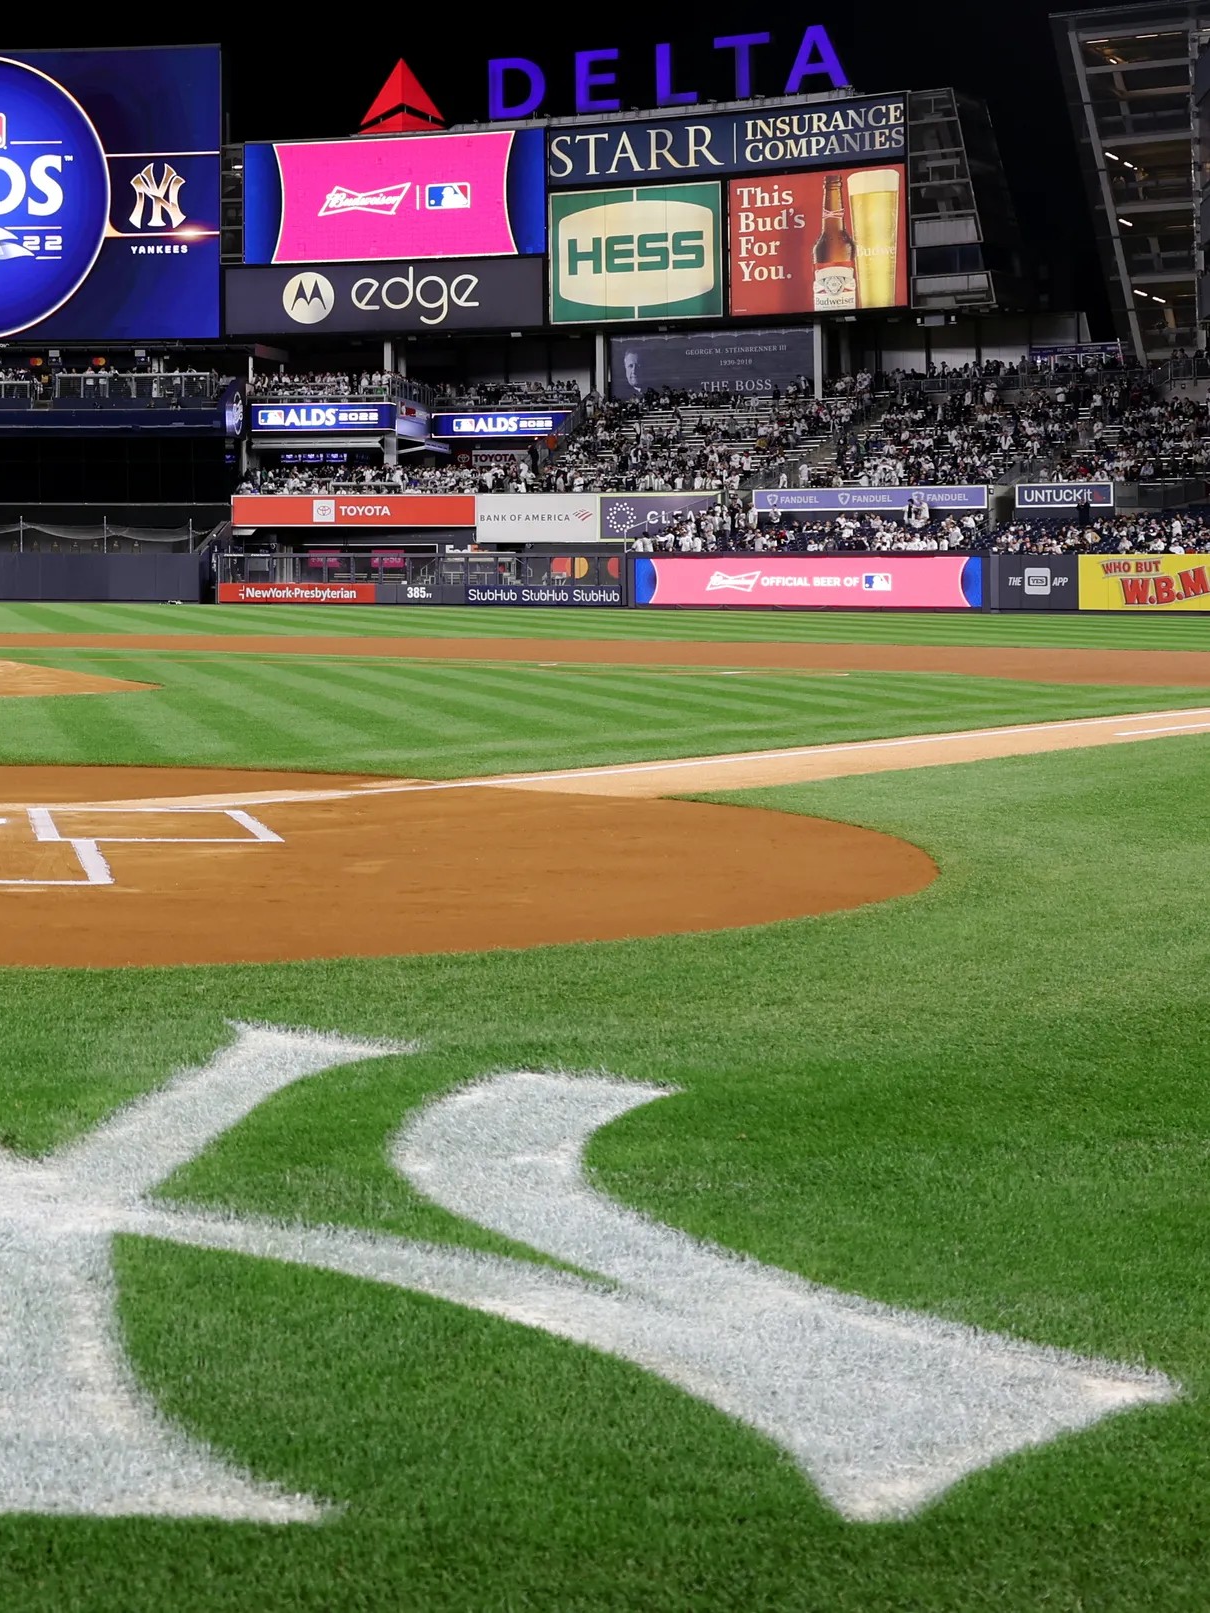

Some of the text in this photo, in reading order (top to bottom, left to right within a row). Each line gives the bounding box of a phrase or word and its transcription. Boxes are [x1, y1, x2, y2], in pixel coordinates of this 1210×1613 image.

[488, 24, 850, 119] DELTA
[745, 103, 905, 140] INSURANCE
[550, 125, 724, 177] STARR
[745, 126, 905, 164] COMPANIES
[737, 185, 793, 208] This
[738, 206, 805, 234] Bud's
[131, 244, 188, 255] YANKEES
[568, 230, 705, 276] HESS
[738, 236, 780, 258] For
[738, 260, 792, 282] You.
[351, 266, 479, 325] edge
[815, 297, 854, 306] Budweiser
[725, 346, 777, 354] STEINBRENNER
[701, 379, 772, 392] THE BOSS
[285, 409, 379, 426] ALDS 2022
[475, 417, 553, 432] ALDS 2022
[473, 454, 516, 462] TOYOTA
[780, 496, 819, 504] FANDUEL
[852, 494, 892, 503] FANDUEL
[927, 493, 968, 502] FANDUEL
[1024, 488, 1092, 502] UNTUCKit
[339, 504, 390, 517] TOYOTA
[480, 513, 570, 522] BANK OF AMERICA
[1102, 560, 1161, 575] WHO BUT
[761, 576, 810, 586] OFFICIAL
[813, 576, 841, 586] BEER
[843, 576, 860, 586] OF
[1008, 577, 1022, 586] THE
[1052, 577, 1068, 586] APP
[468, 590, 620, 602] StubHub StubHub StubHub
